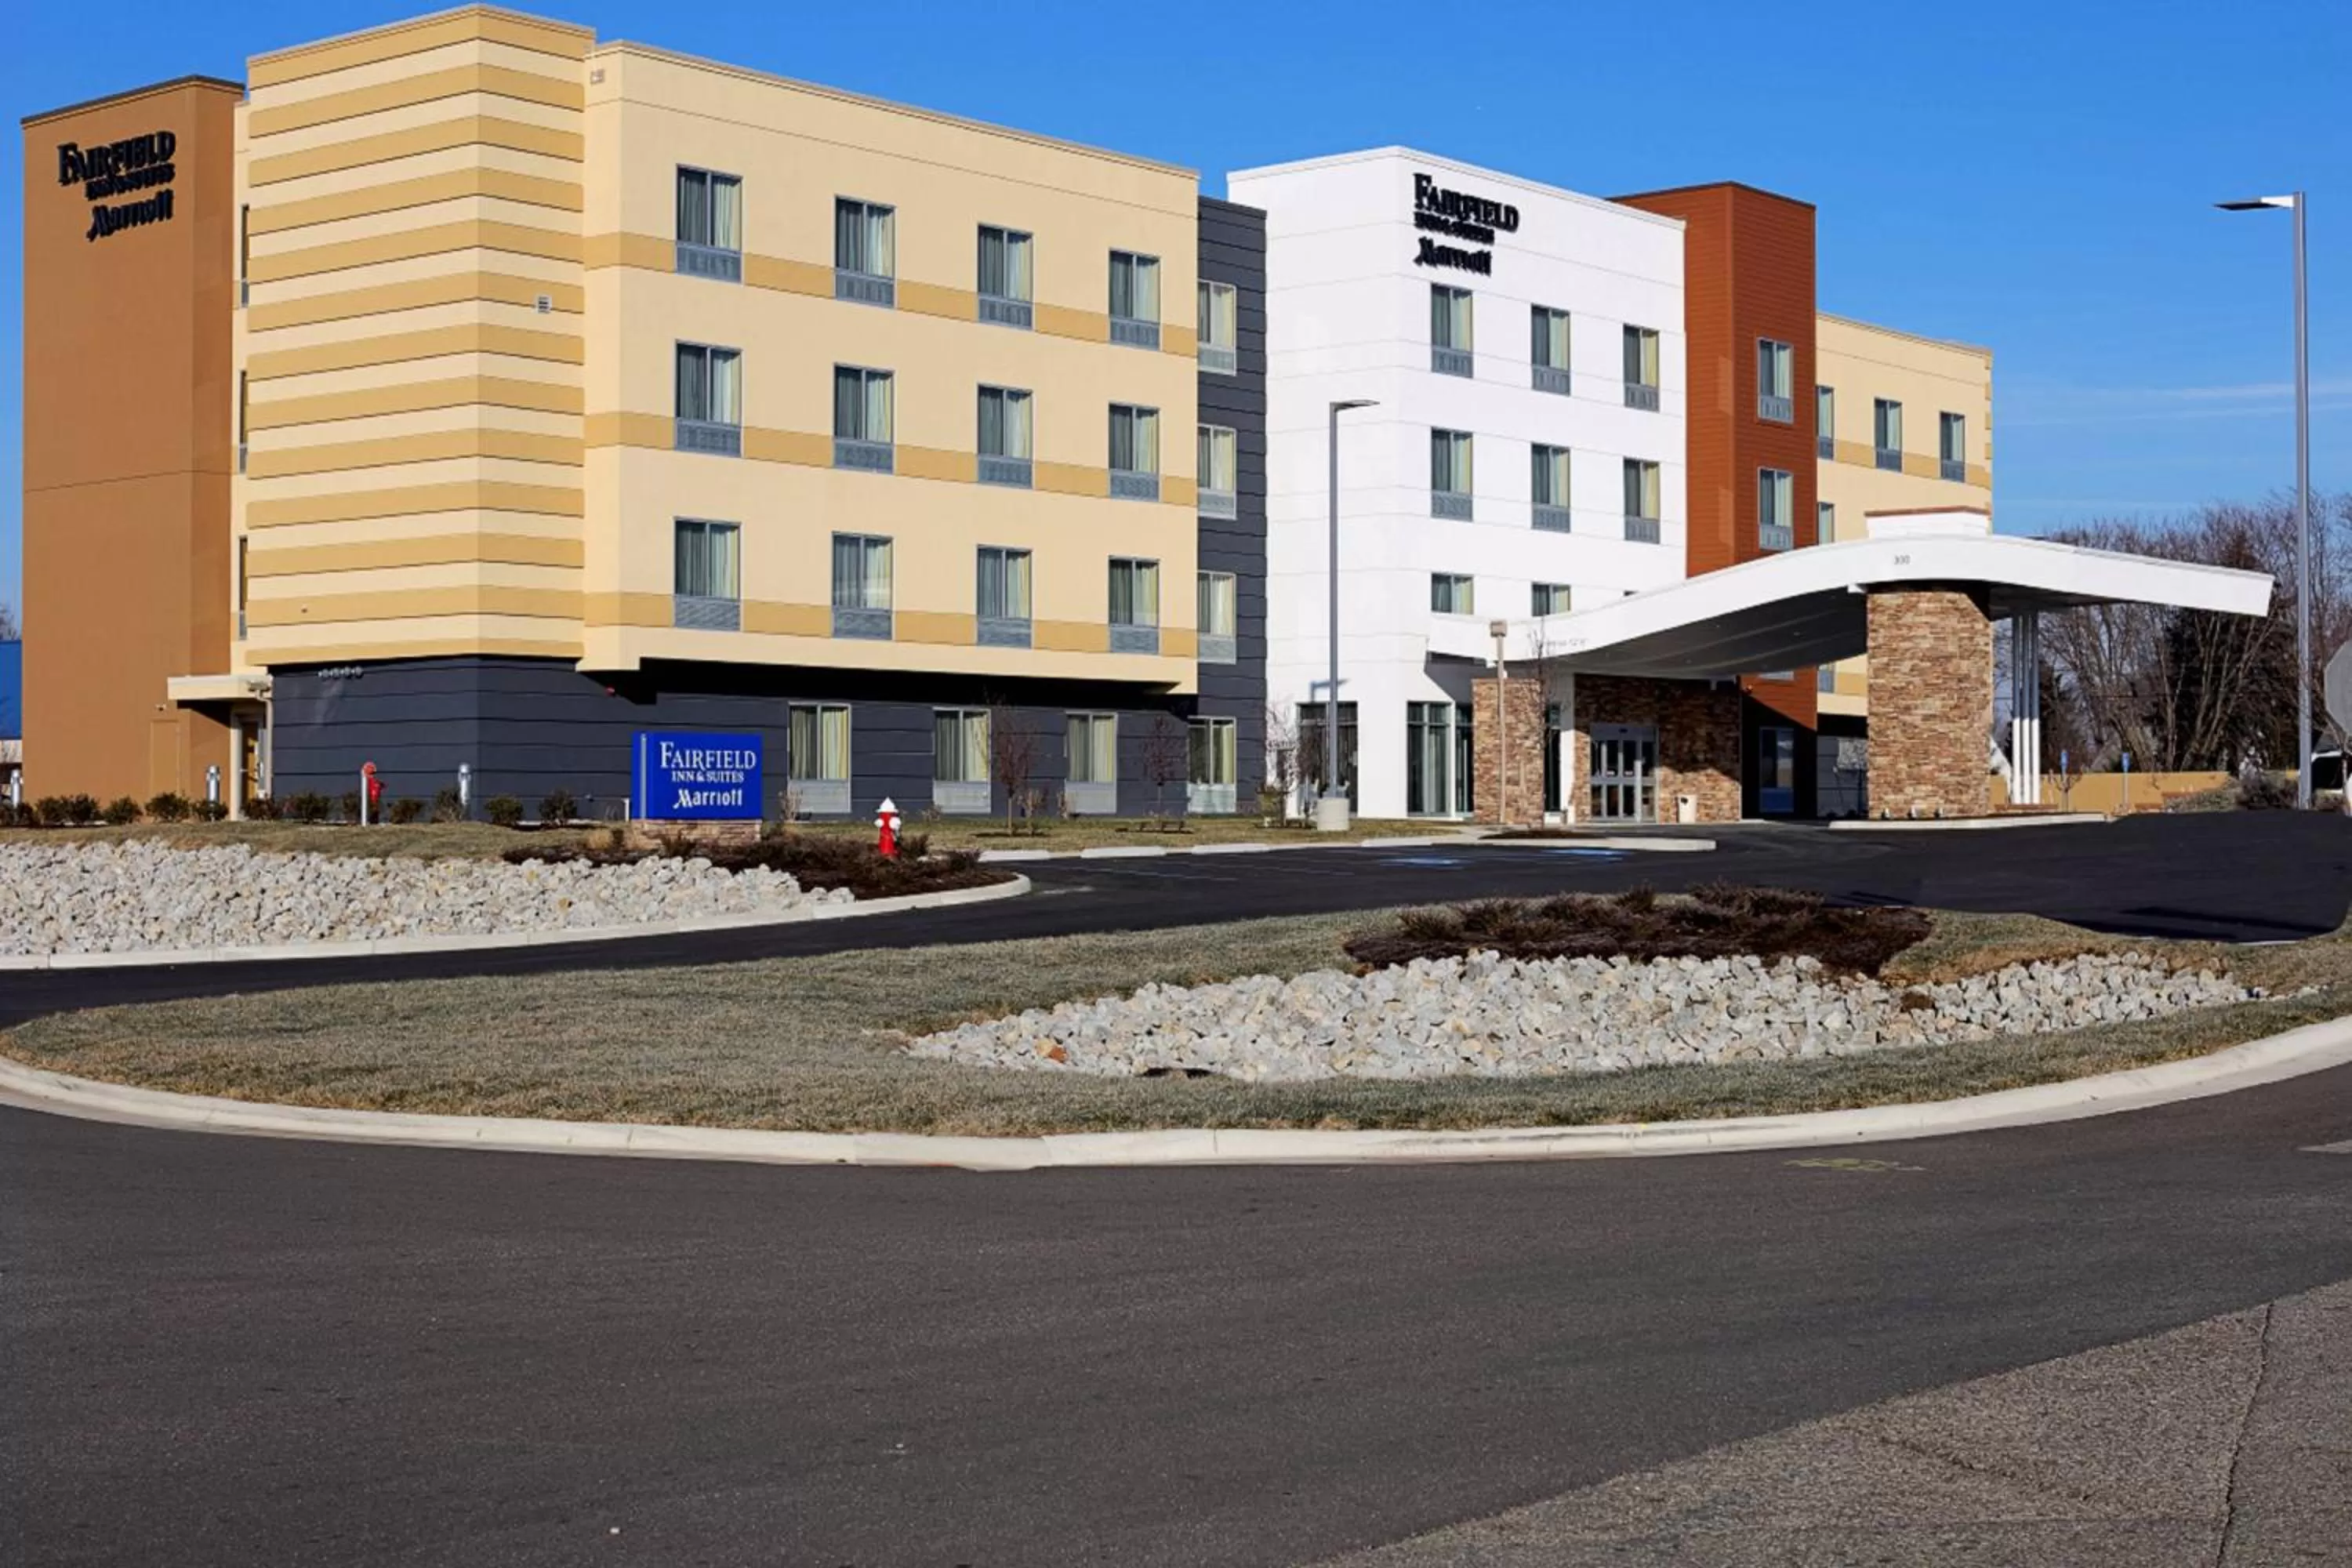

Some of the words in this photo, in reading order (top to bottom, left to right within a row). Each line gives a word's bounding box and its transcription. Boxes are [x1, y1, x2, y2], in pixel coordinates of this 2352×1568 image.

[1414, 172, 1520, 234] FAIRFIELD
[659, 741, 757, 771] FAIRFIELD
[671, 771, 695, 782] INN
[706, 771, 745, 783] SUITES
[673, 787, 743, 809] Marriott
